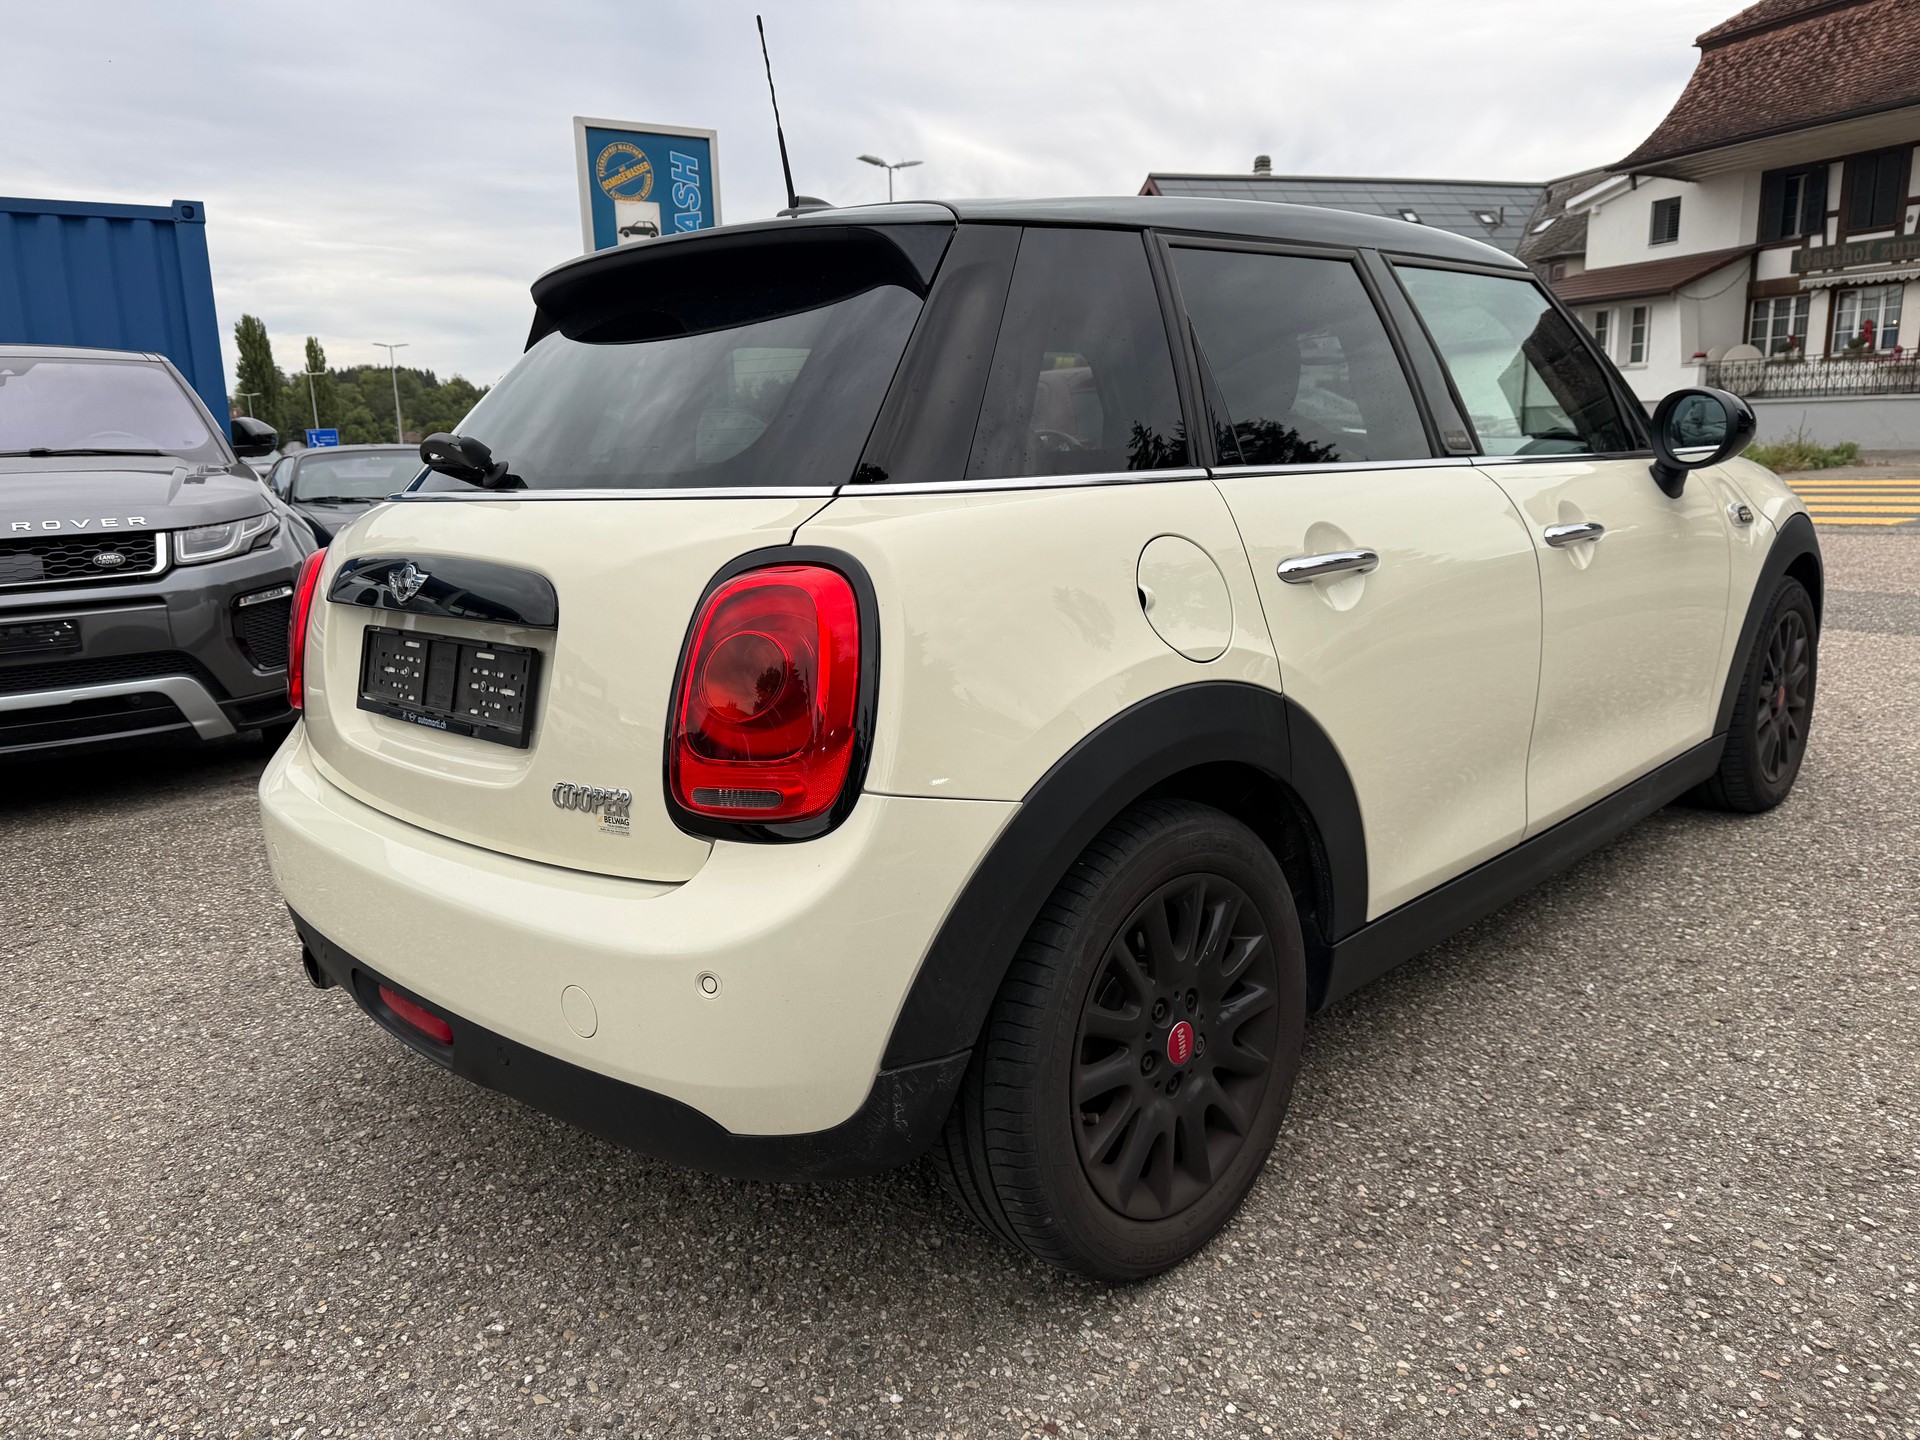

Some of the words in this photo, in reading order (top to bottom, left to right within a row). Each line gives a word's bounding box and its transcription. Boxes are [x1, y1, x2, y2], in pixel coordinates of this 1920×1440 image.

[602, 161, 650, 190] OSMOSEWASSER
[669, 150, 702, 234] ASH
[1799, 241, 1874, 269] Gasthof
[11, 516, 147, 532] ROVER
[552, 781, 632, 818] COOPER
[603, 815, 630, 826] BELWAG
[1177, 1027, 1187, 1059] MINI
